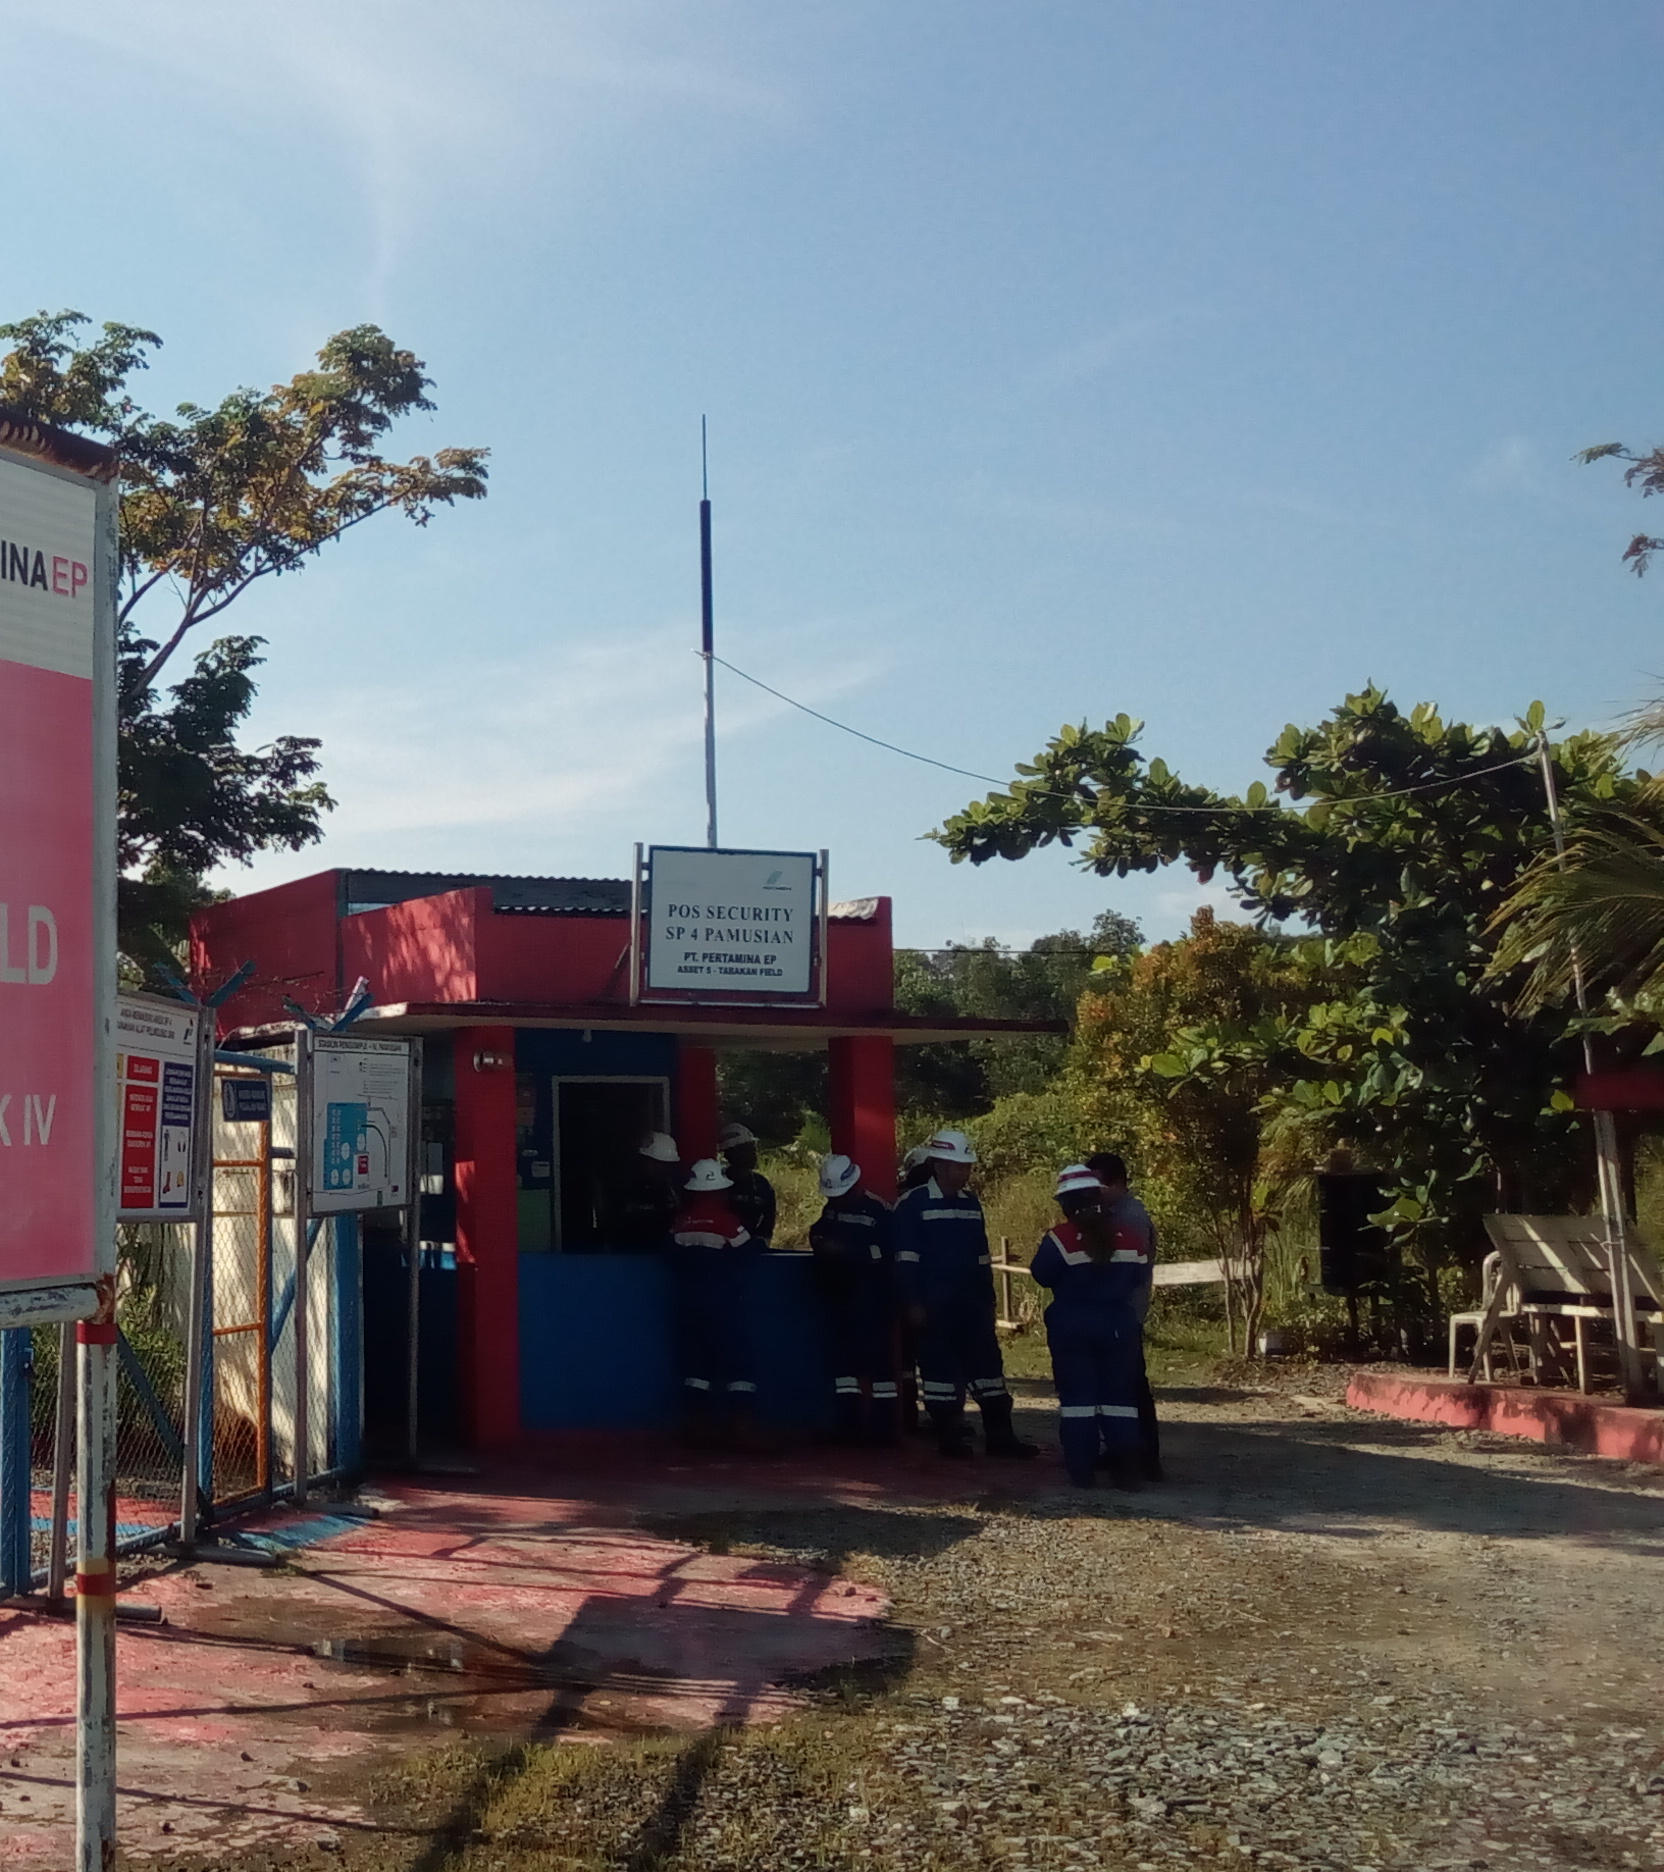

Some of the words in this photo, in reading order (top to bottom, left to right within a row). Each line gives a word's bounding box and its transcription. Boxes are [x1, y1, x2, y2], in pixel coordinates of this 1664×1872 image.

[668, 904, 700, 919] POS
[706, 905, 793, 922] SECURITY
[666, 926, 685, 940] SP
[690, 927, 698, 941] 4
[705, 927, 793, 944] PAMUSIAN
[702, 952, 761, 965] PERTAMINA
[764, 954, 777, 965] EP
[677, 965, 704, 974] ASSET
[719, 966, 758, 976] TARAKAN
[760, 968, 783, 977] FIELD
[24, 1093, 56, 1146] IV
